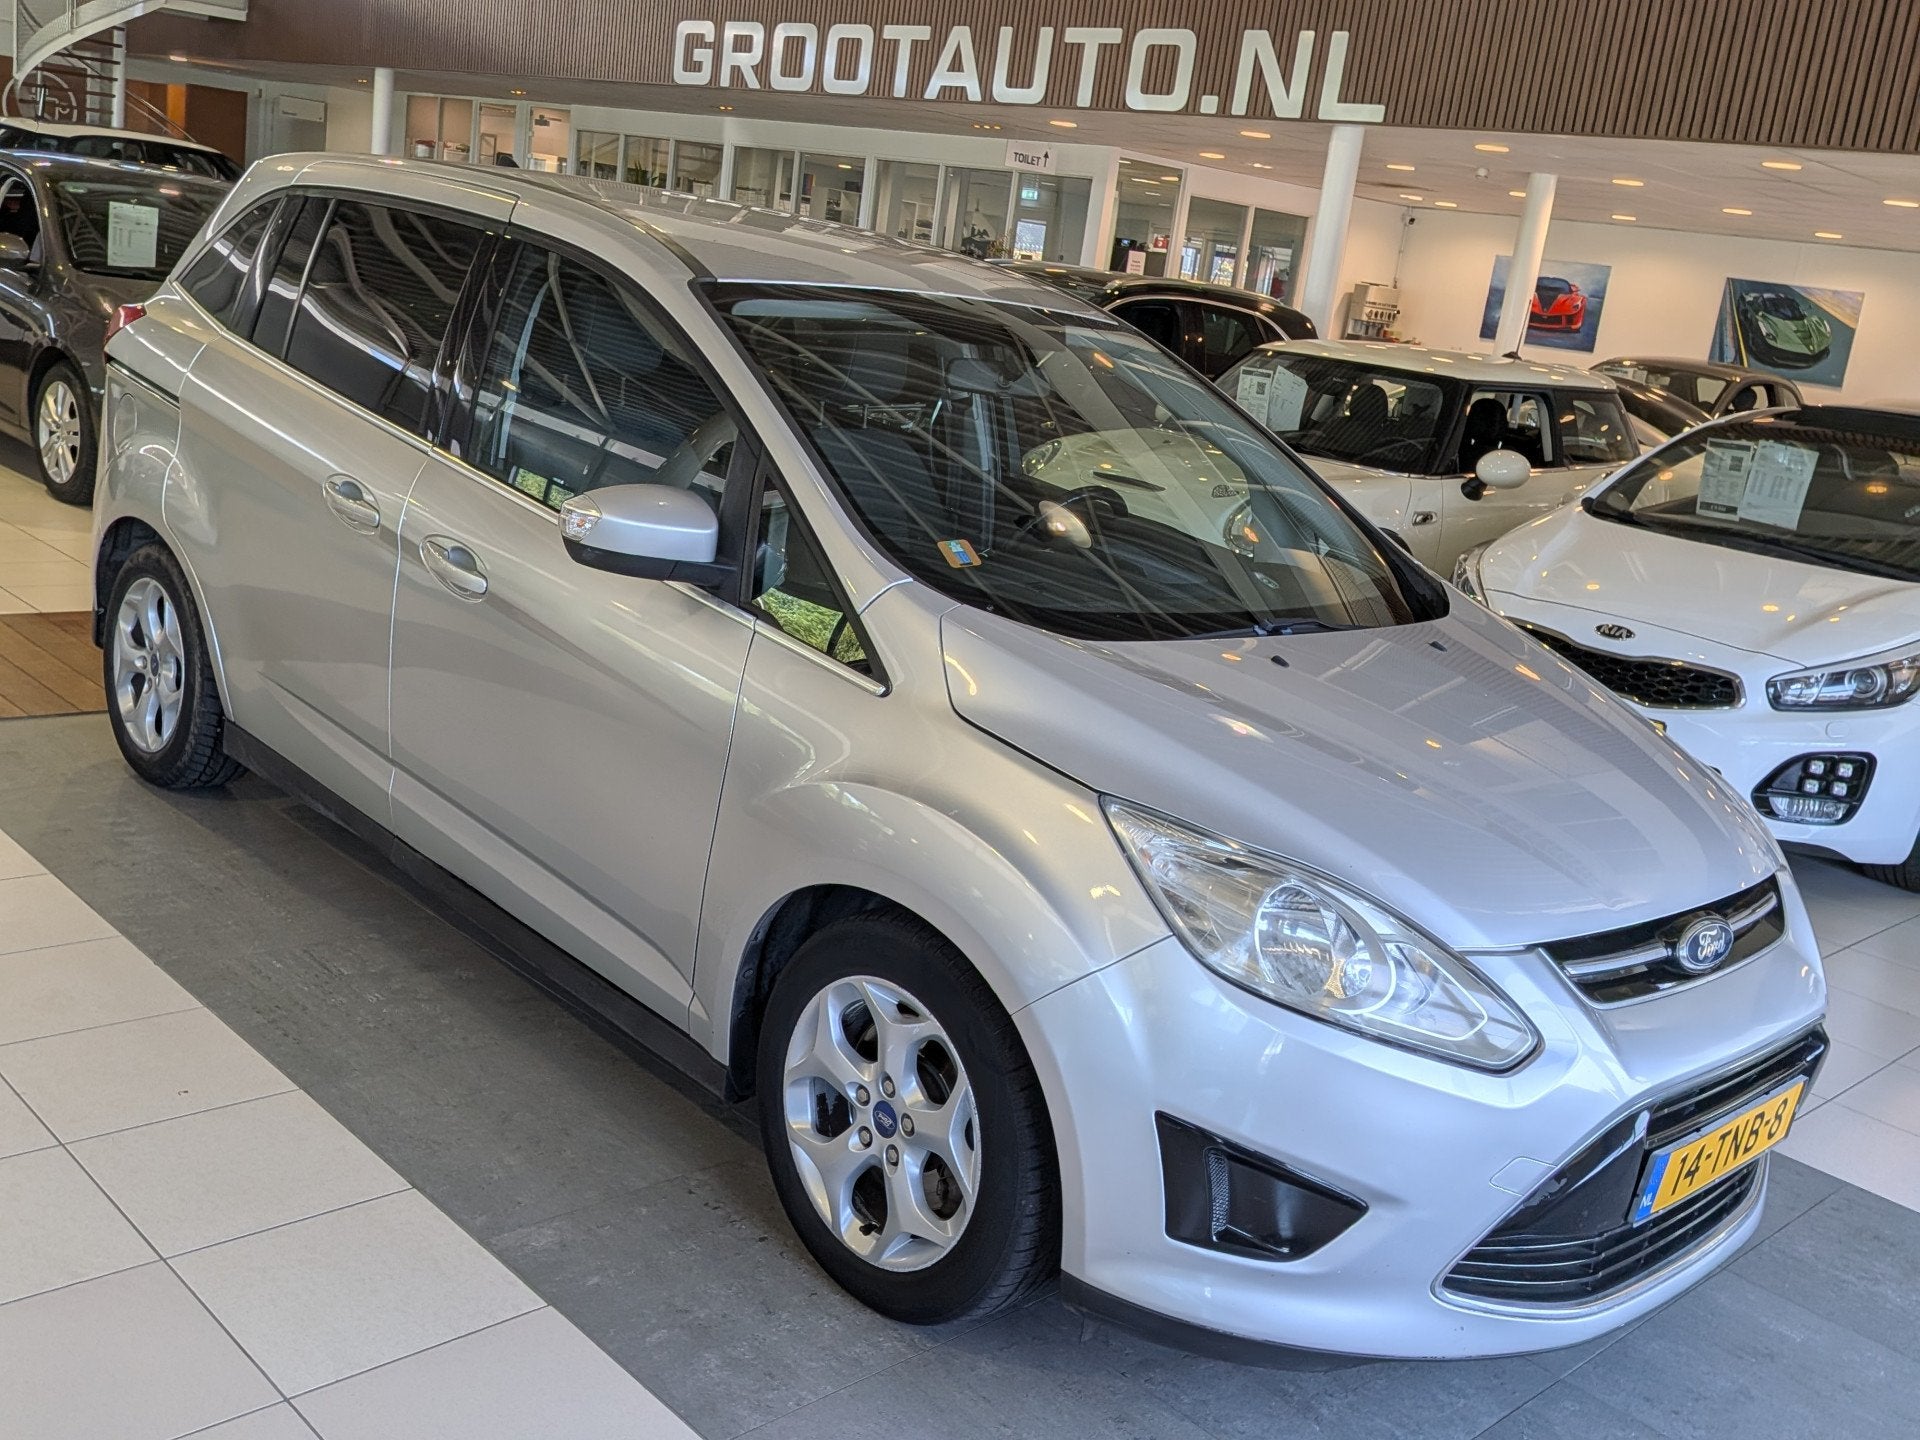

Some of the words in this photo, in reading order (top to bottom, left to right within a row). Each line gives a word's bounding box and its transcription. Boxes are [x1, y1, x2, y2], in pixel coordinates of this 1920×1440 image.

[673, 20, 1386, 123] GROOTAUTO.NL
[1013, 151, 1041, 167] TOILET
[1600, 624, 1628, 639] KIA
[1697, 928, 1726, 961] Ford
[1670, 1097, 1789, 1197] 14-TNB-8
[1639, 1192, 1653, 1209] NL
